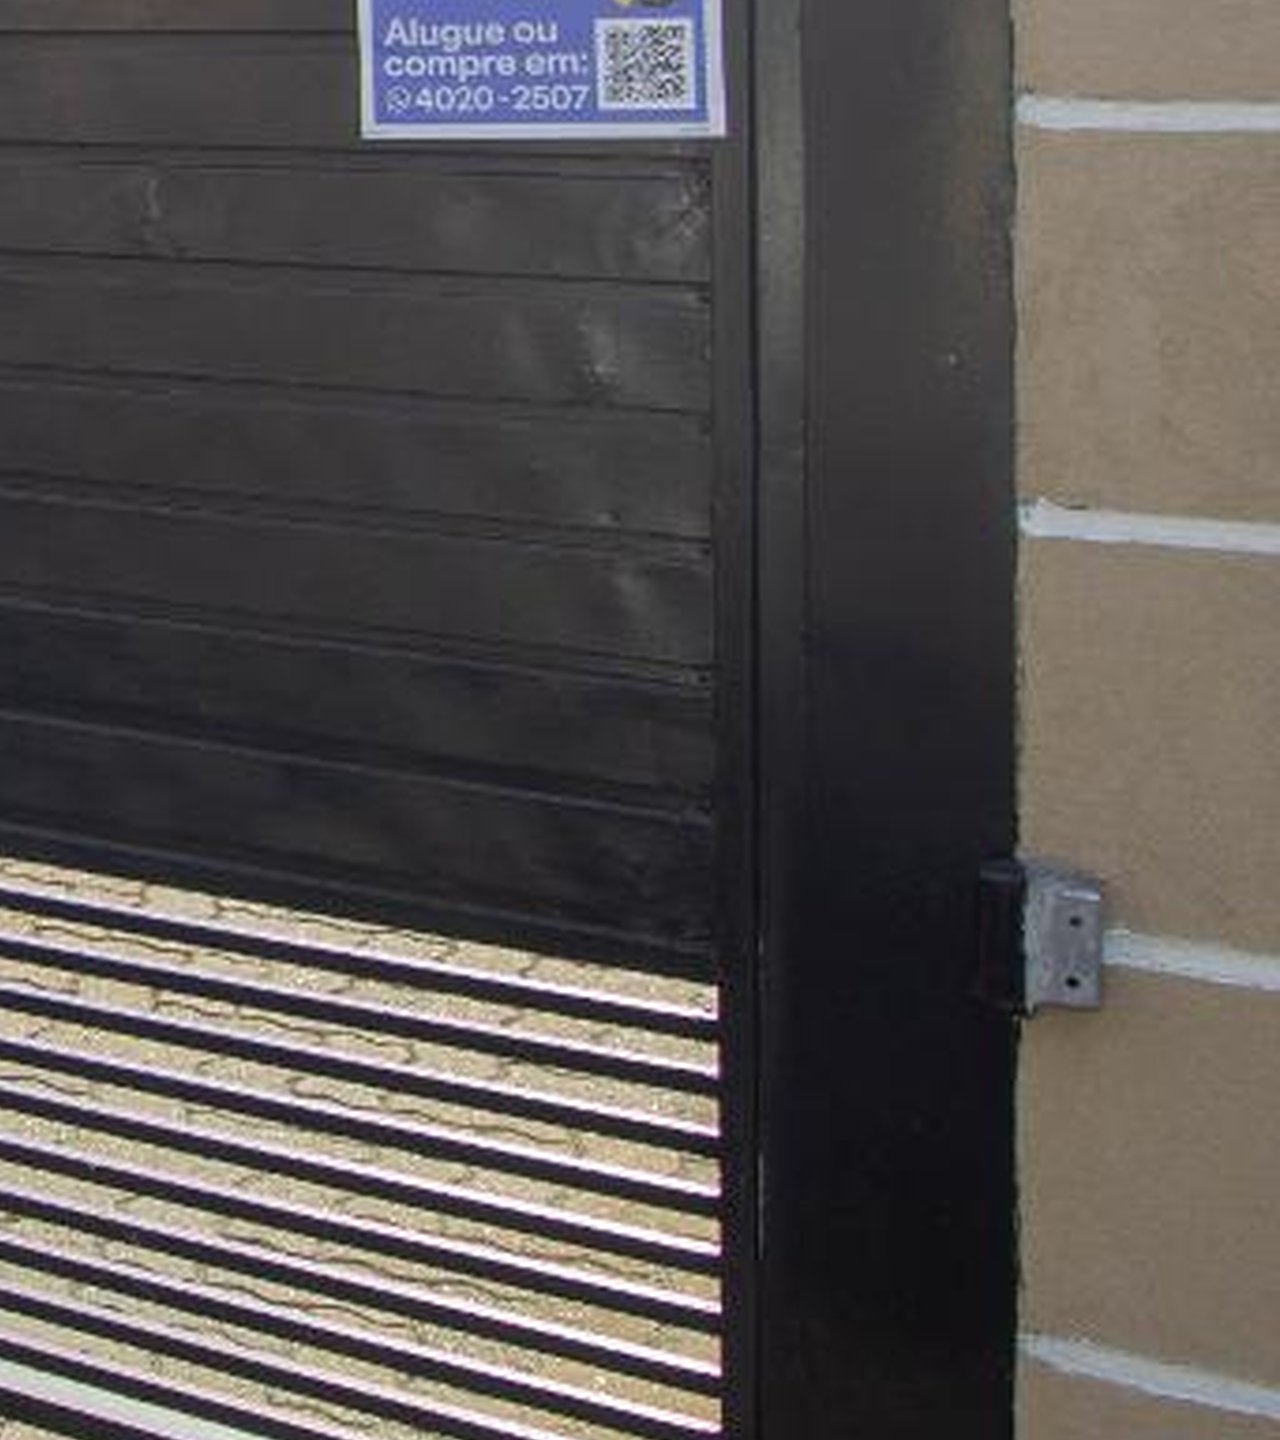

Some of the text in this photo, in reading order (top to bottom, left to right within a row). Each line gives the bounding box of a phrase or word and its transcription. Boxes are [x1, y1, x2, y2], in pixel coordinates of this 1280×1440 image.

[383, 17, 559, 53] Alugue ou
[384, 50, 589, 83] compre em:
[414, 84, 591, 113] 4020-2507
